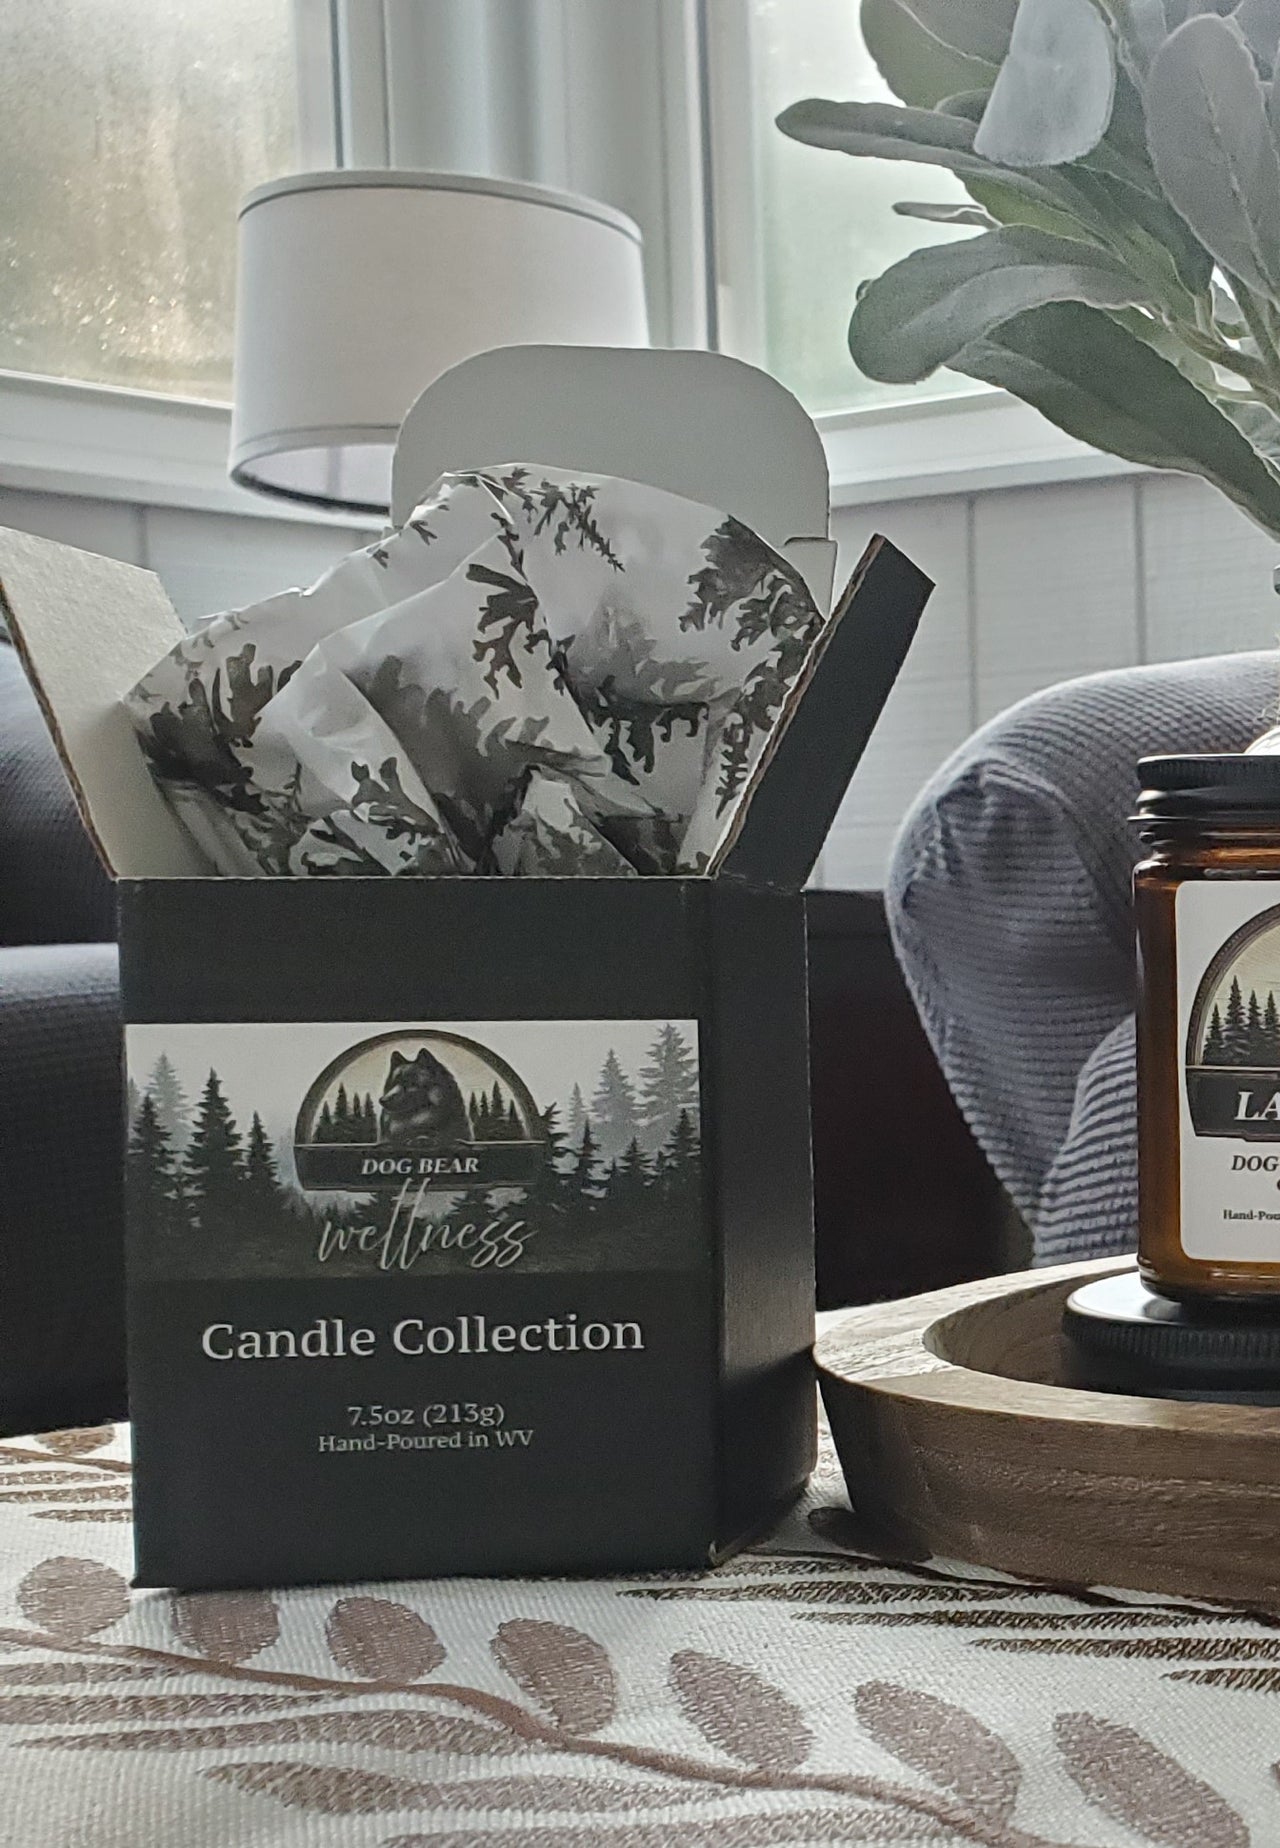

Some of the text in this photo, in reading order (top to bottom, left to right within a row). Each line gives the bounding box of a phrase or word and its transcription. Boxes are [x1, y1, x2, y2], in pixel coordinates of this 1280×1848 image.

[361, 1157, 479, 1175] DOG BEAR
[1231, 1154, 1279, 1172] DOG
[318, 1177, 539, 1270] wellness
[201, 1313, 645, 1360] Candle Collection
[347, 1403, 505, 1428] 7.5oz (213g)
[318, 1429, 534, 1452] Hand-Poured in WV
